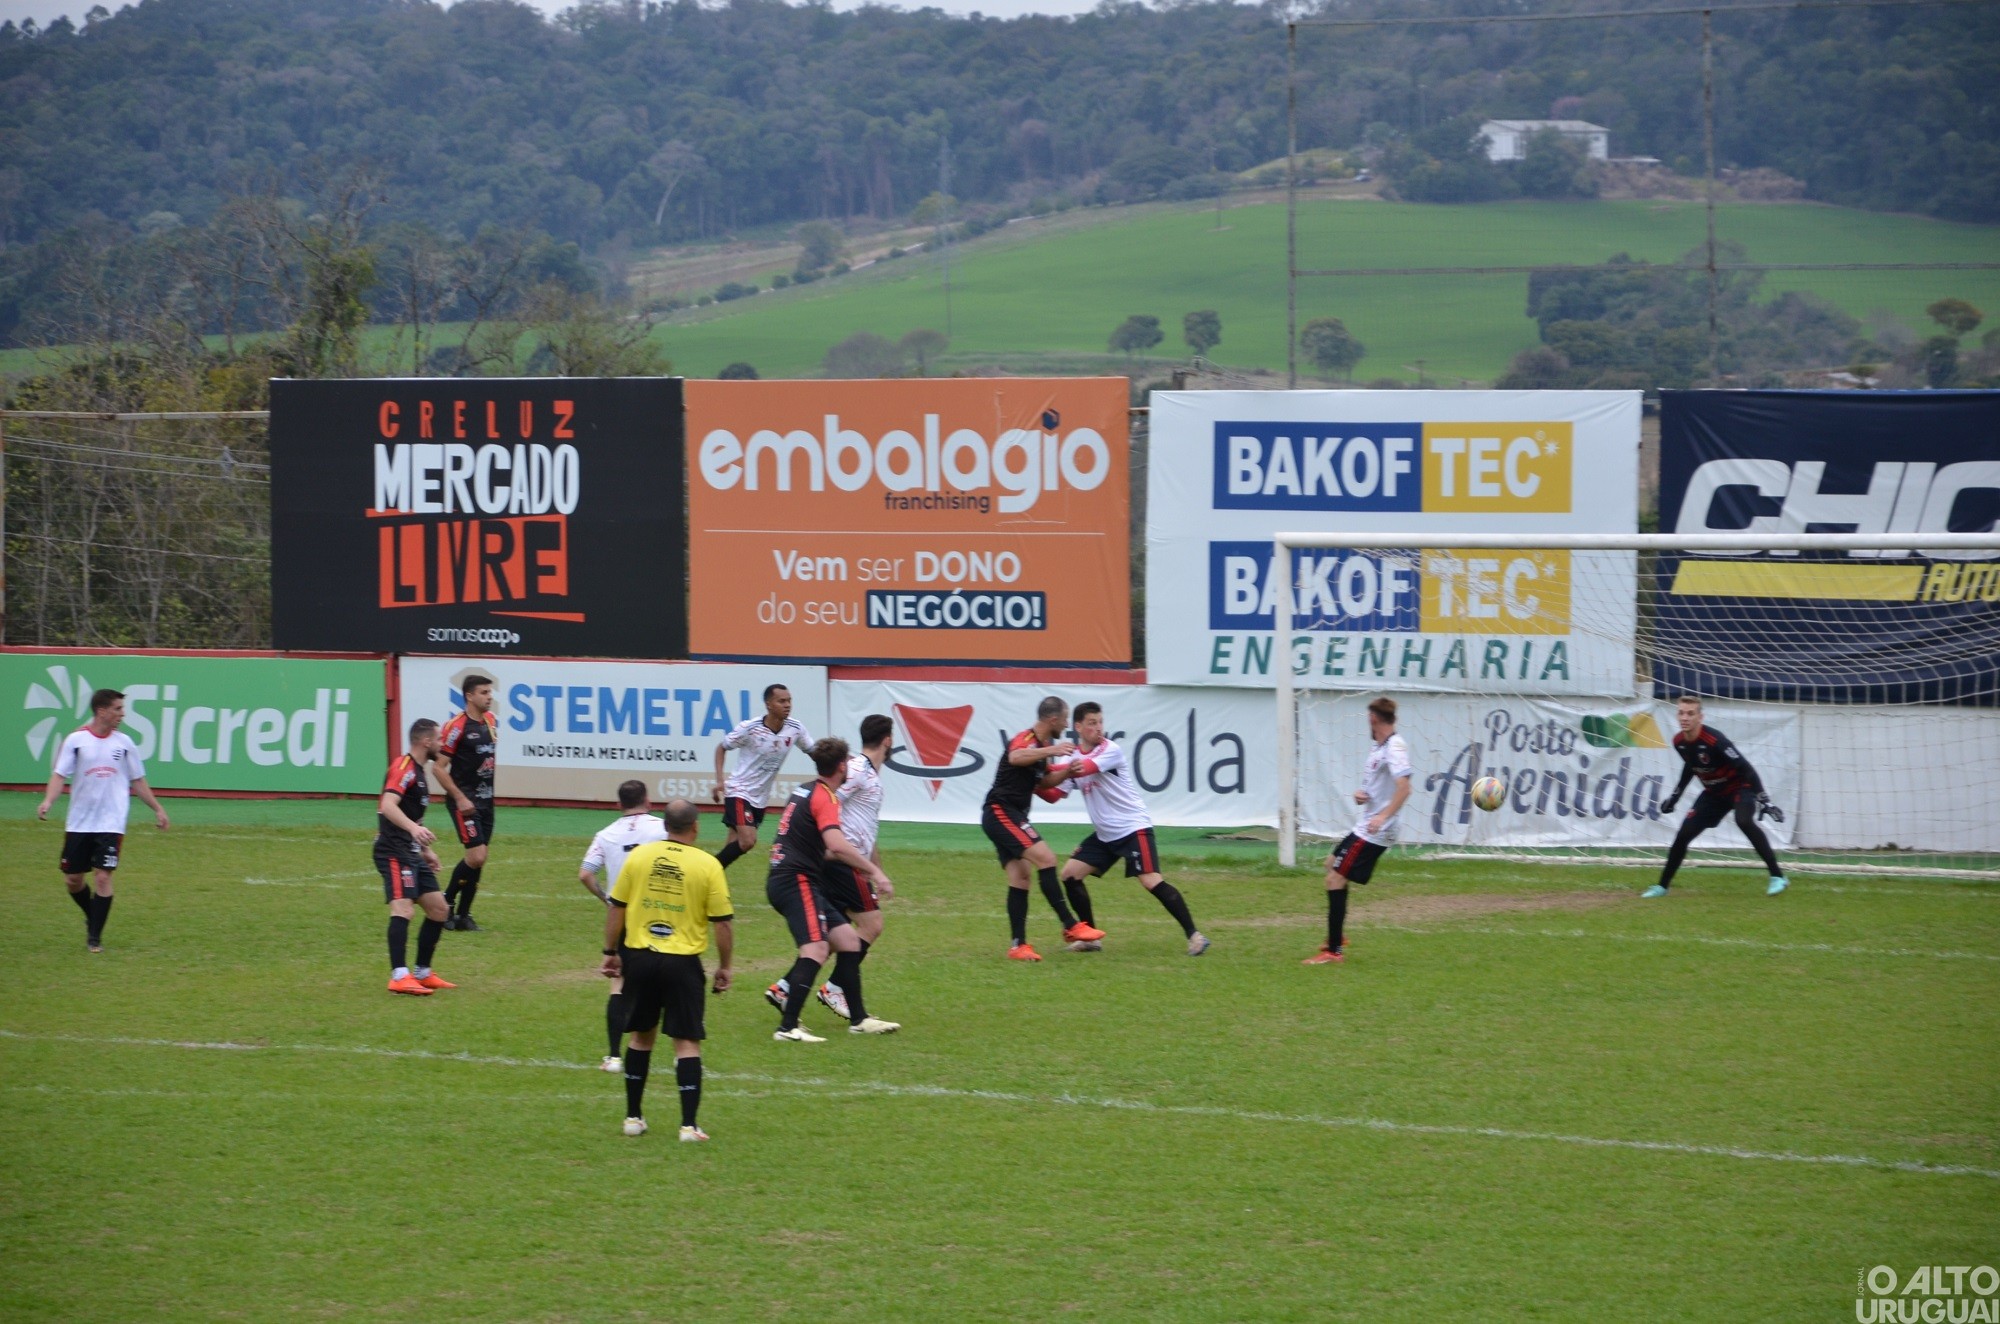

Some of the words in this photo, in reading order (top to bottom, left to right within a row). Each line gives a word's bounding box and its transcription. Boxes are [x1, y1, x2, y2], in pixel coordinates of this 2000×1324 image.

[379, 400, 575, 438] CRELUZ
[374, 443, 580, 515] MERCADO
[700, 409, 1110, 513] embalagio
[1228, 436, 1413, 497] BAKOF
[1430, 436, 1541, 498] TEC
[885, 491, 990, 513] franchising
[379, 514, 568, 608] LIVRE
[773, 549, 847, 581] Vem
[857, 557, 904, 581] ser
[915, 550, 1021, 583] DONO
[757, 592, 795, 625] do
[804, 600, 858, 625] seu
[870, 588, 1041, 628] NEGÓCIO!
[1428, 556, 1539, 620] TEC
[1210, 636, 1570, 680] ENGENHARIA
[120, 684, 350, 767] Sicredi
[1485, 709, 1578, 756] Posto
[523, 742, 595, 760] INDÚSTRIA
[599, 744, 697, 762] METALÚRGICA
